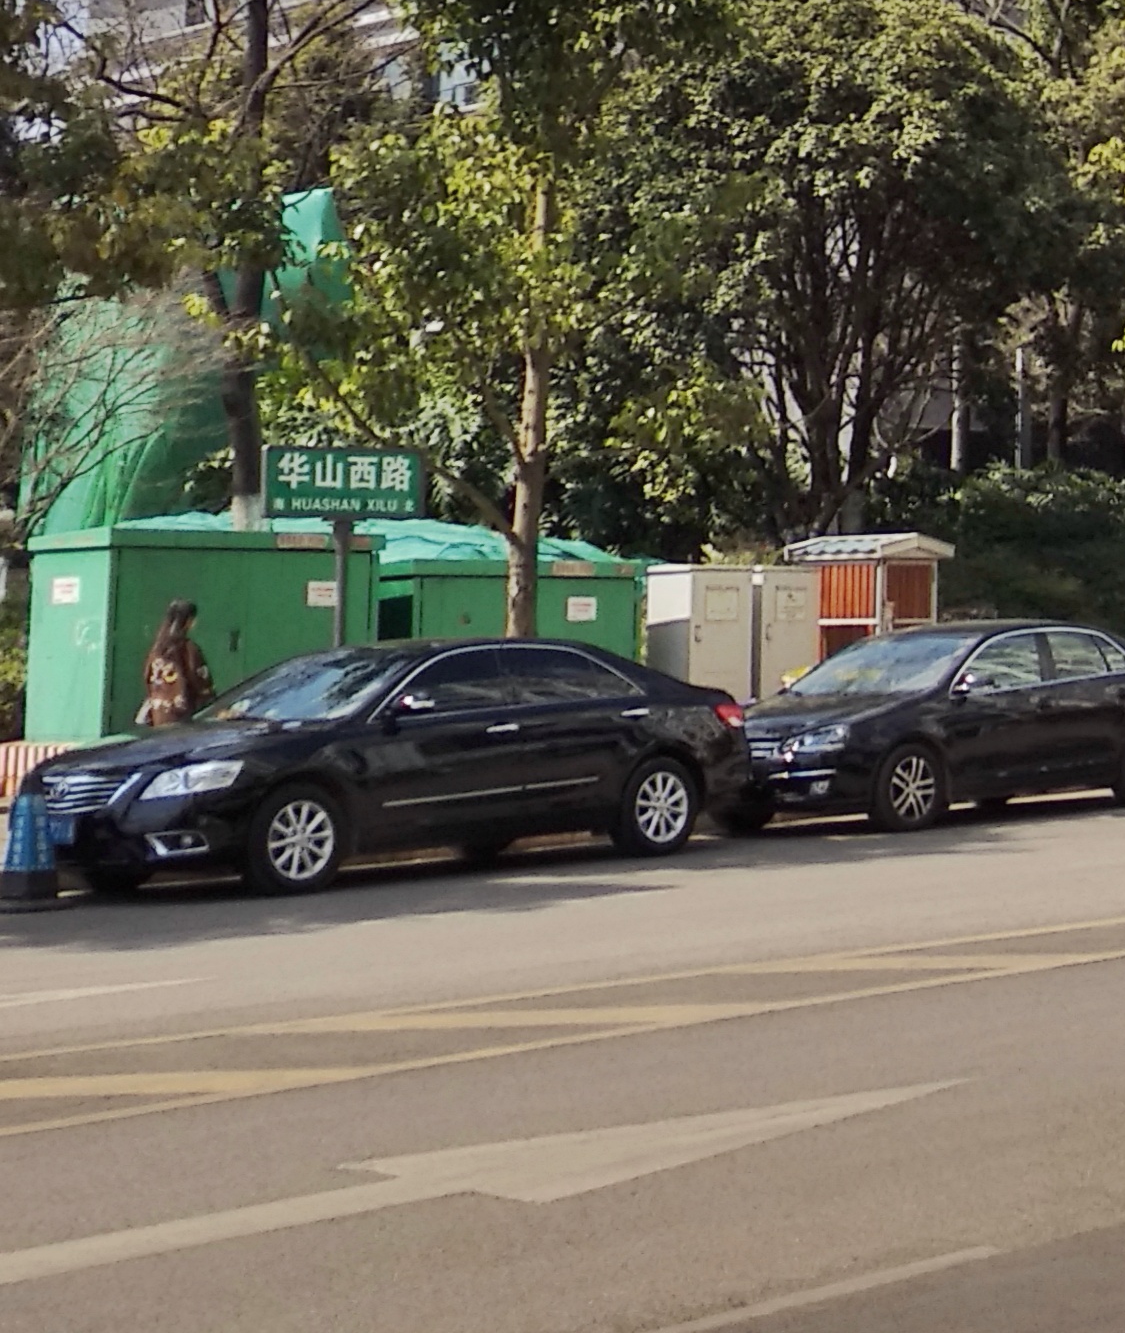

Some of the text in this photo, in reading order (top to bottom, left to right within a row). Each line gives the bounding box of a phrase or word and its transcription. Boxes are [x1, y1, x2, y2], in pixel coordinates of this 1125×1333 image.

[277, 452, 413, 491] 华山西路
[291, 498, 361, 511] HUASHAN
[366, 499, 398, 511] XILU
